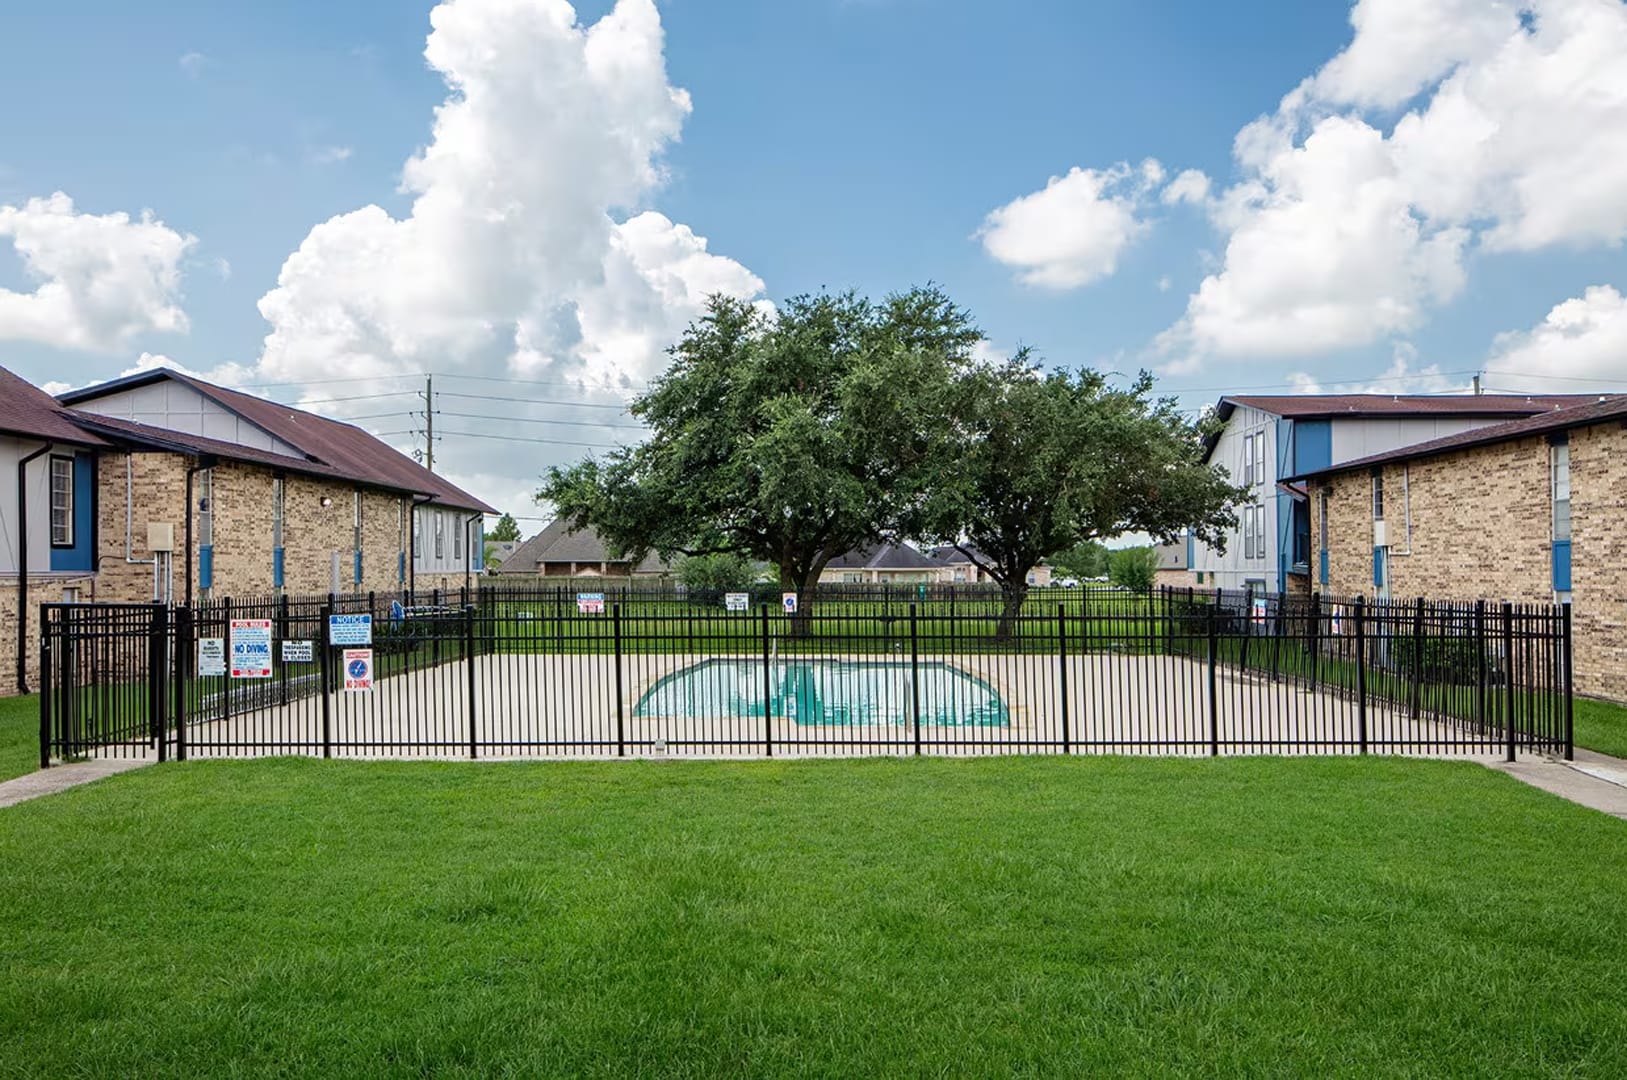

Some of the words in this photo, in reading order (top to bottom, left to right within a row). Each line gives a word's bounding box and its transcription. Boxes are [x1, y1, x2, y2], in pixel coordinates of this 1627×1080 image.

[337, 615, 364, 624] NOTICE
[235, 644, 245, 654] NO
[346, 680, 353, 689] NO
